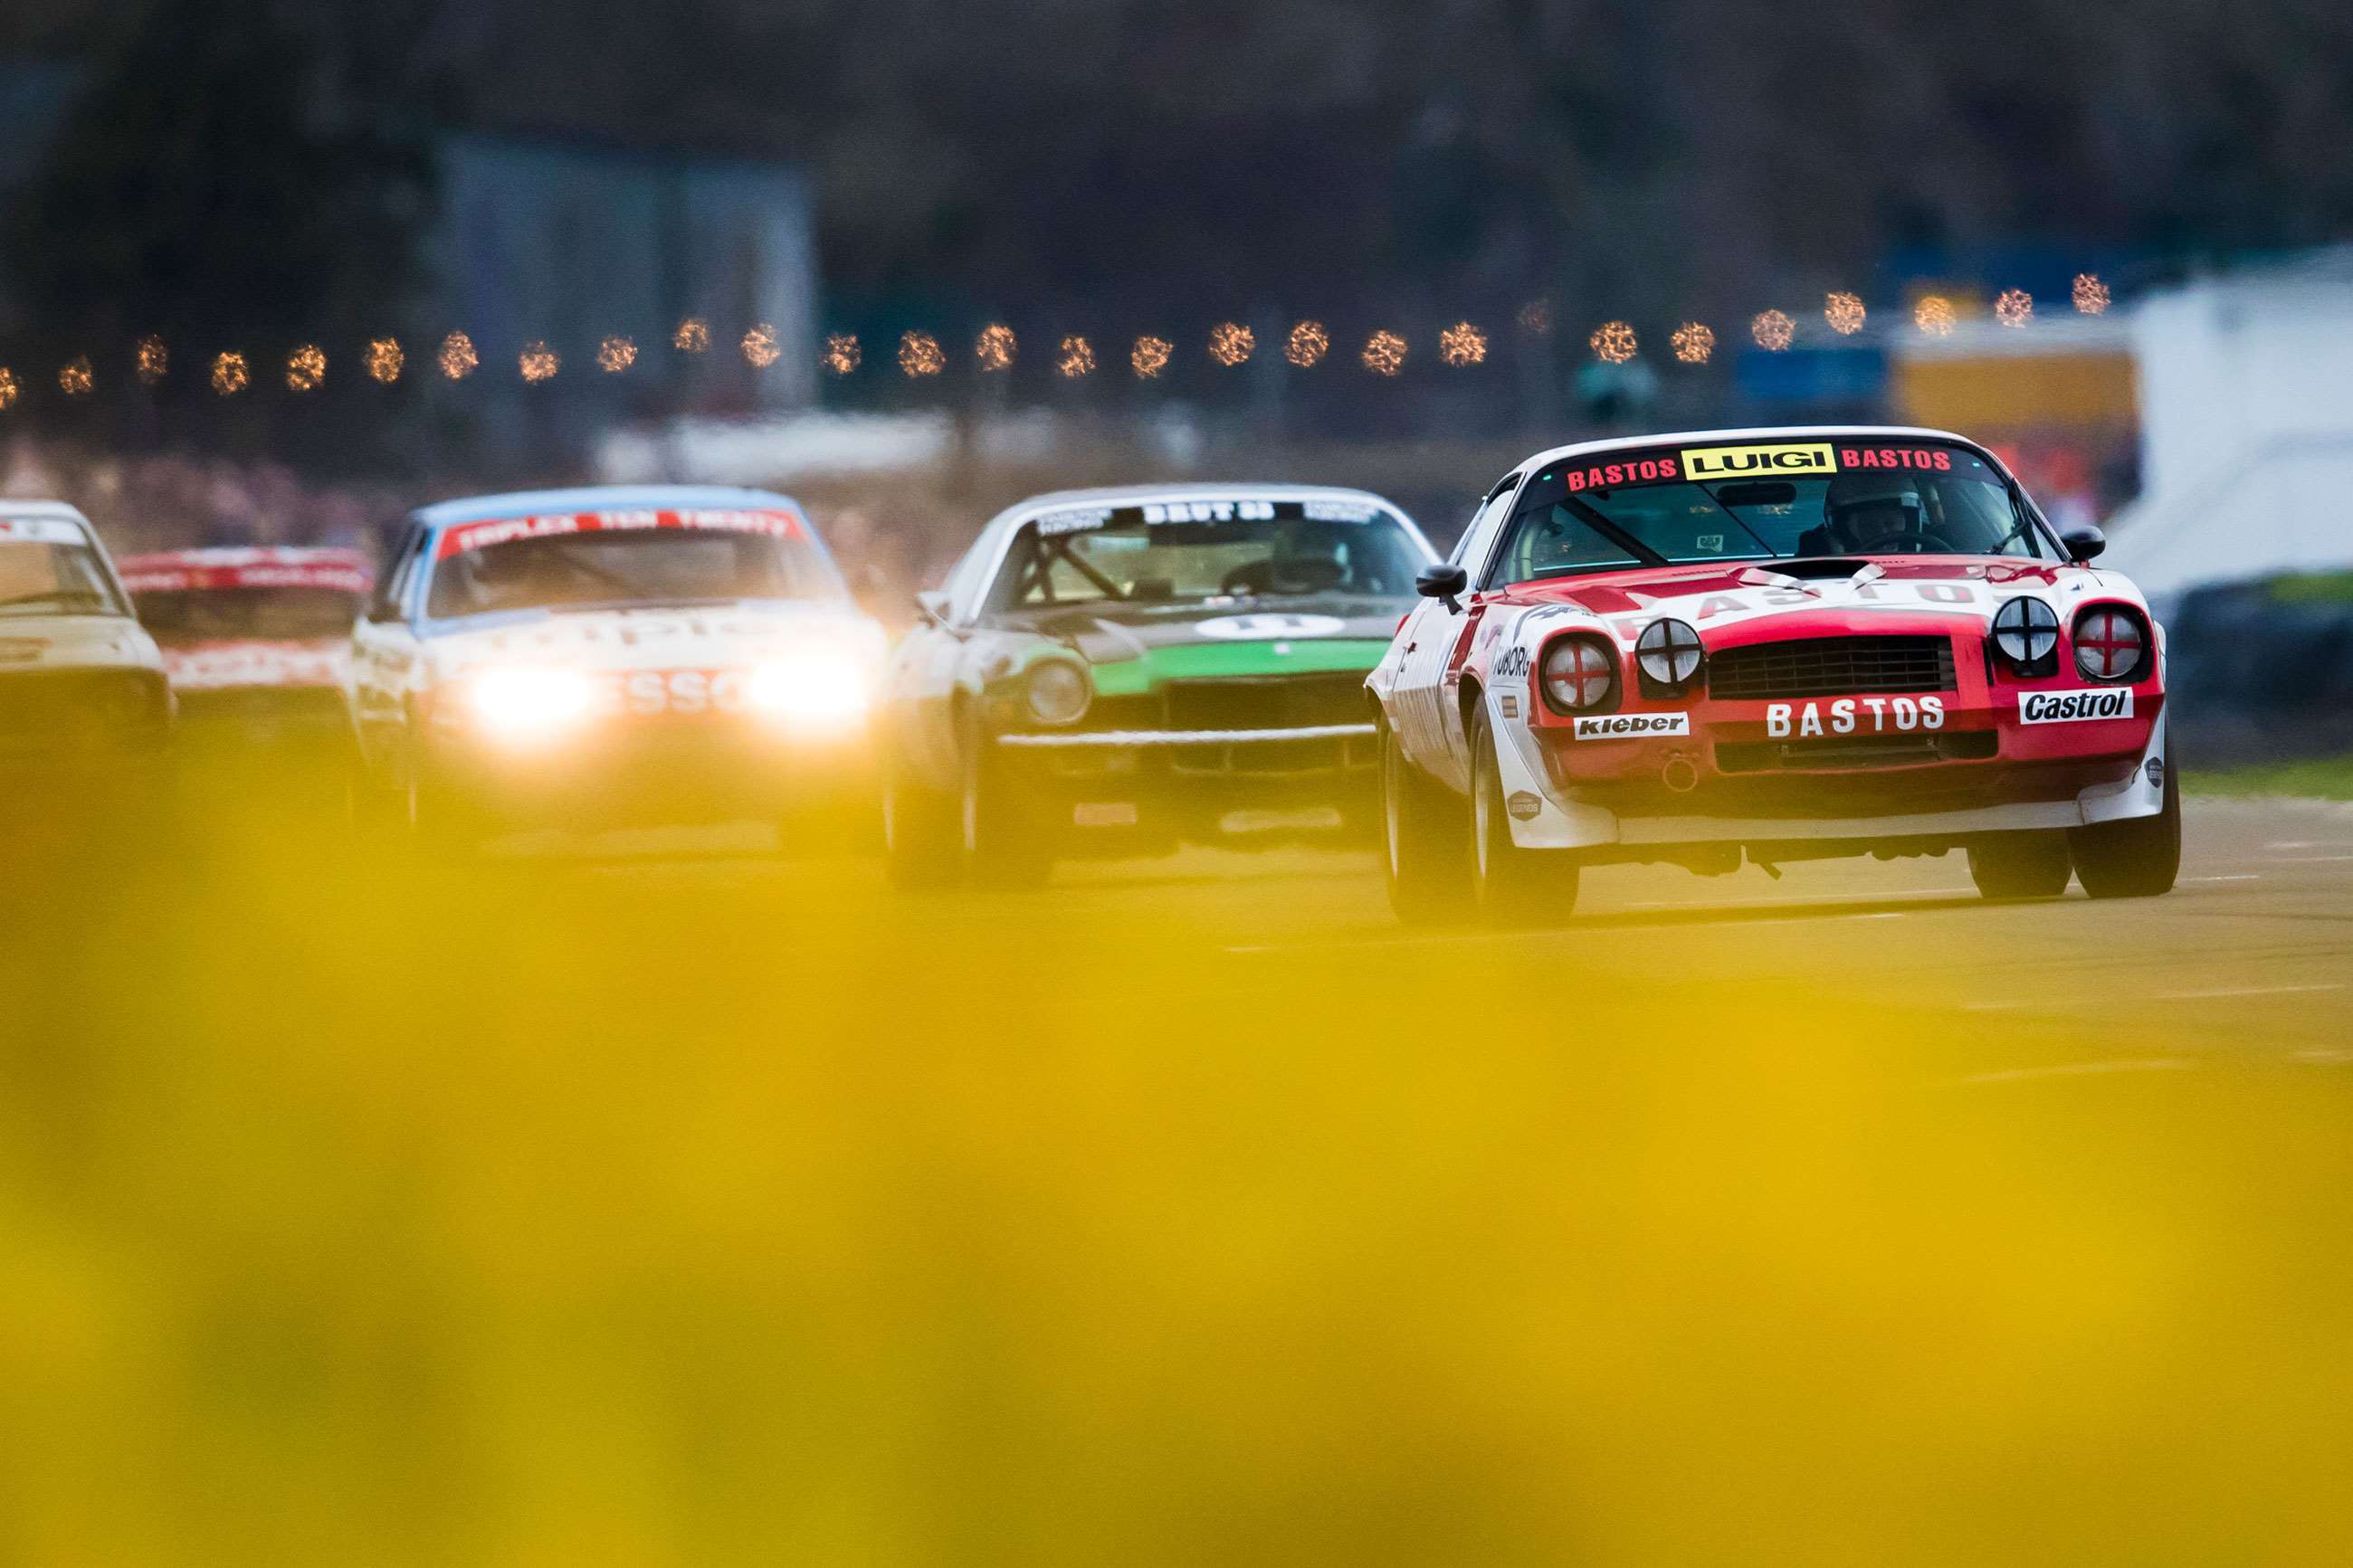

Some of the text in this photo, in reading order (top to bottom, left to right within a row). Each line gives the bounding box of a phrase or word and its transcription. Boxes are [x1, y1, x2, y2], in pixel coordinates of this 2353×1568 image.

[1567, 450, 1951, 491] BASTOS LUIGI BASTOS
[1767, 696, 1944, 737] BASTOS
[2024, 689, 2129, 721] Castrol
